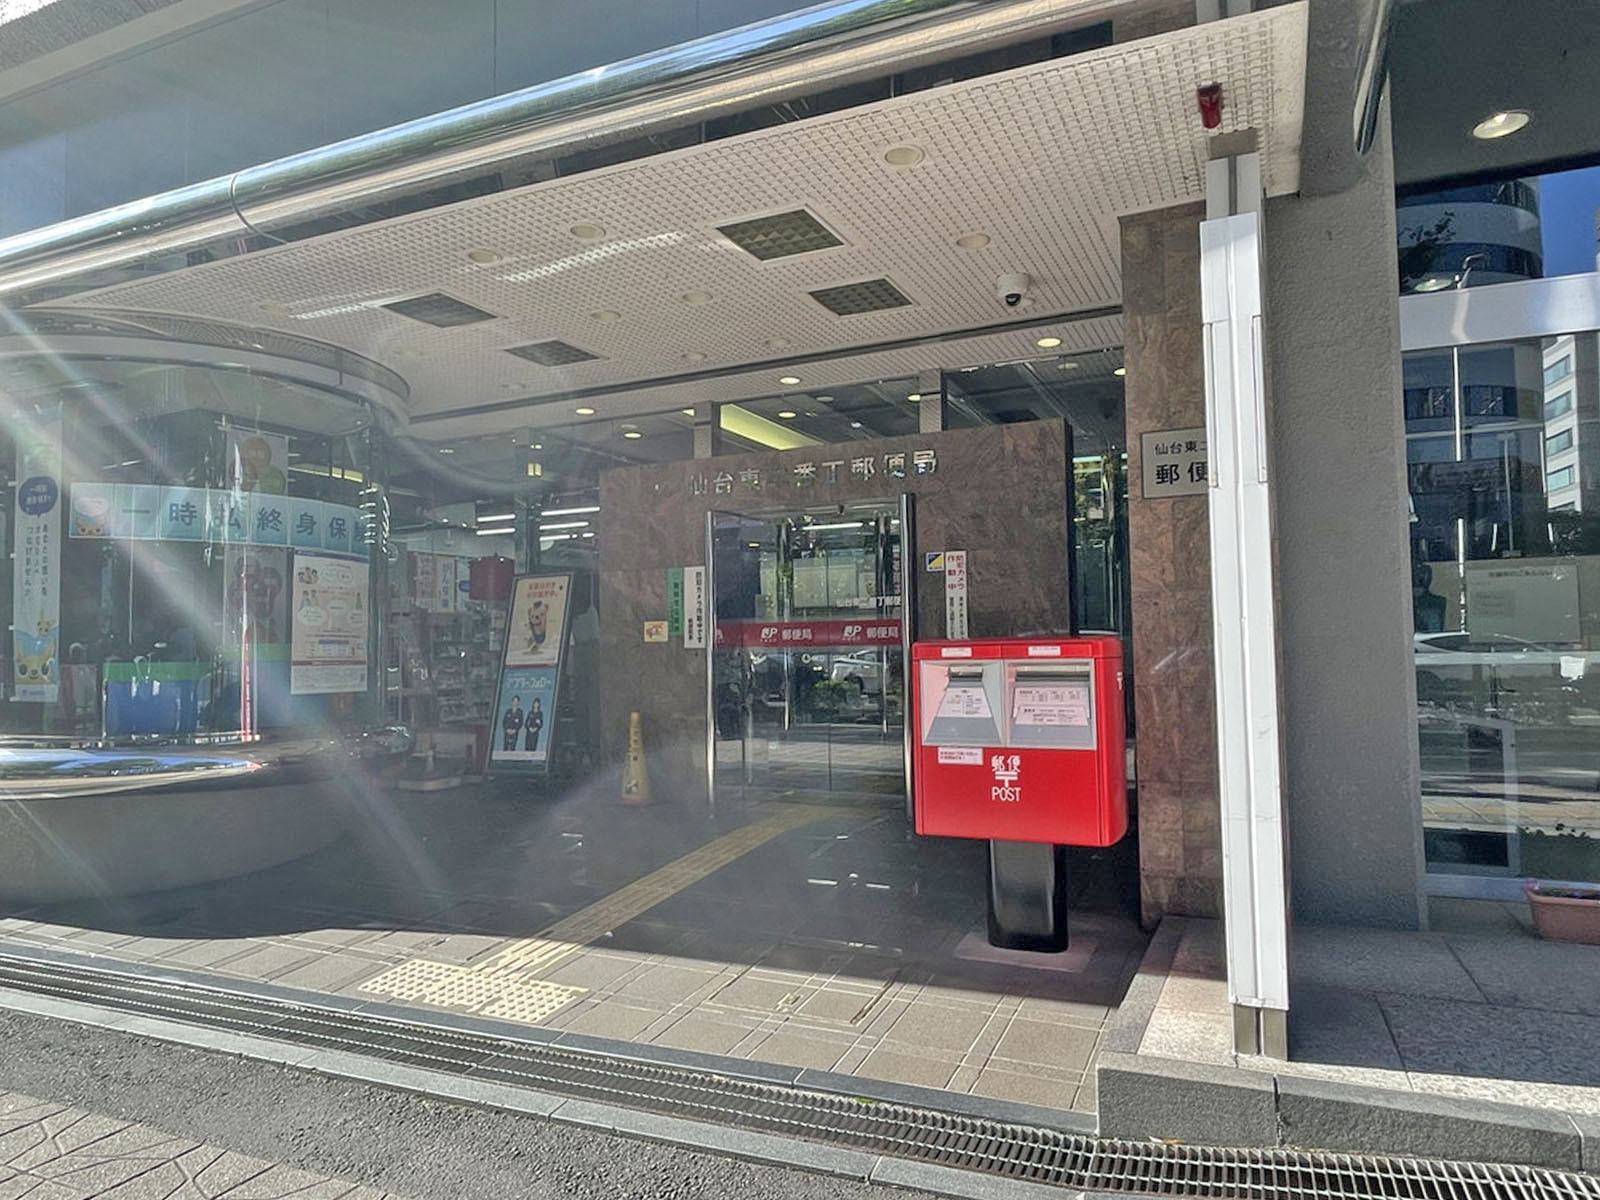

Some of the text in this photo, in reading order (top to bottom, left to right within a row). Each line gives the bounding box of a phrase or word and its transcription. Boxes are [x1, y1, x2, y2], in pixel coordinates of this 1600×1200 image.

[689, 449, 936, 496] 仙台東番丁郵便局
[992, 755, 1021, 772] 郵便
[991, 786, 1021, 802] POST
